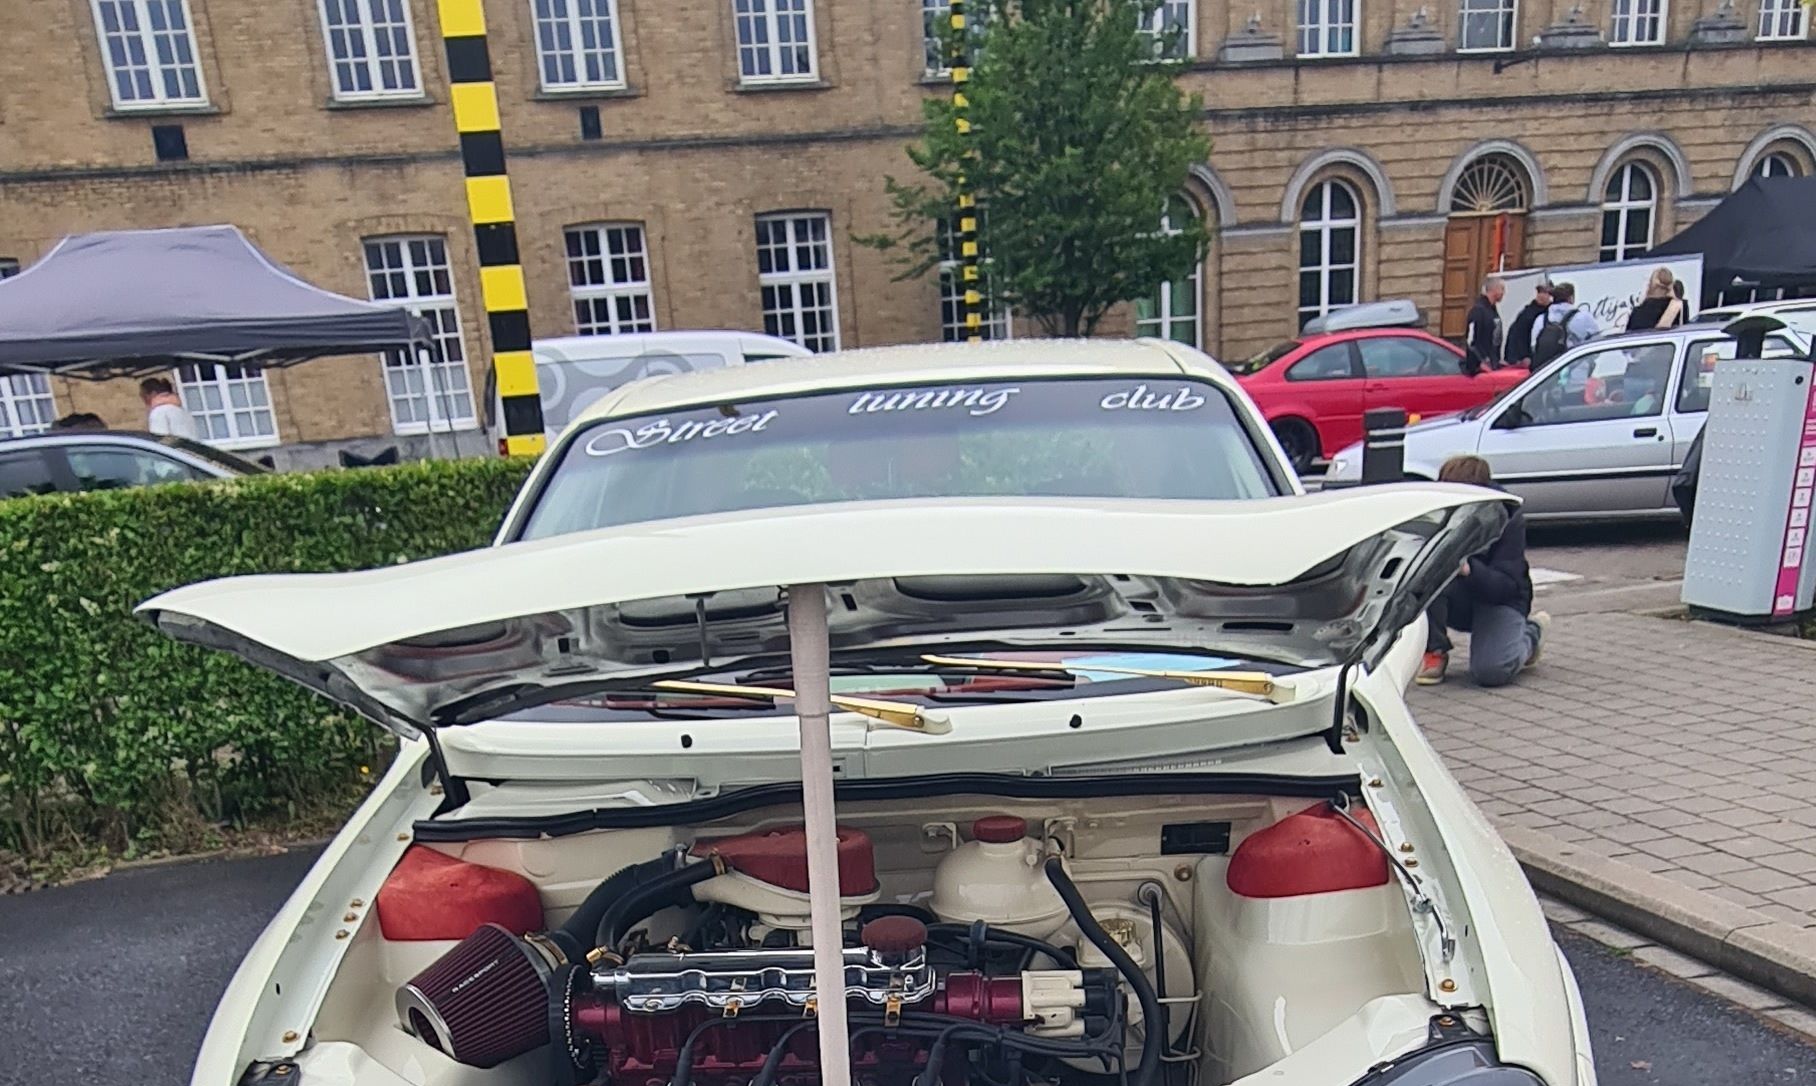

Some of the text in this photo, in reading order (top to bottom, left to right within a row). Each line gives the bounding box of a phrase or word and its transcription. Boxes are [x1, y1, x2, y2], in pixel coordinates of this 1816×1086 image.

[585, 383, 1206, 457] Street tuning club
